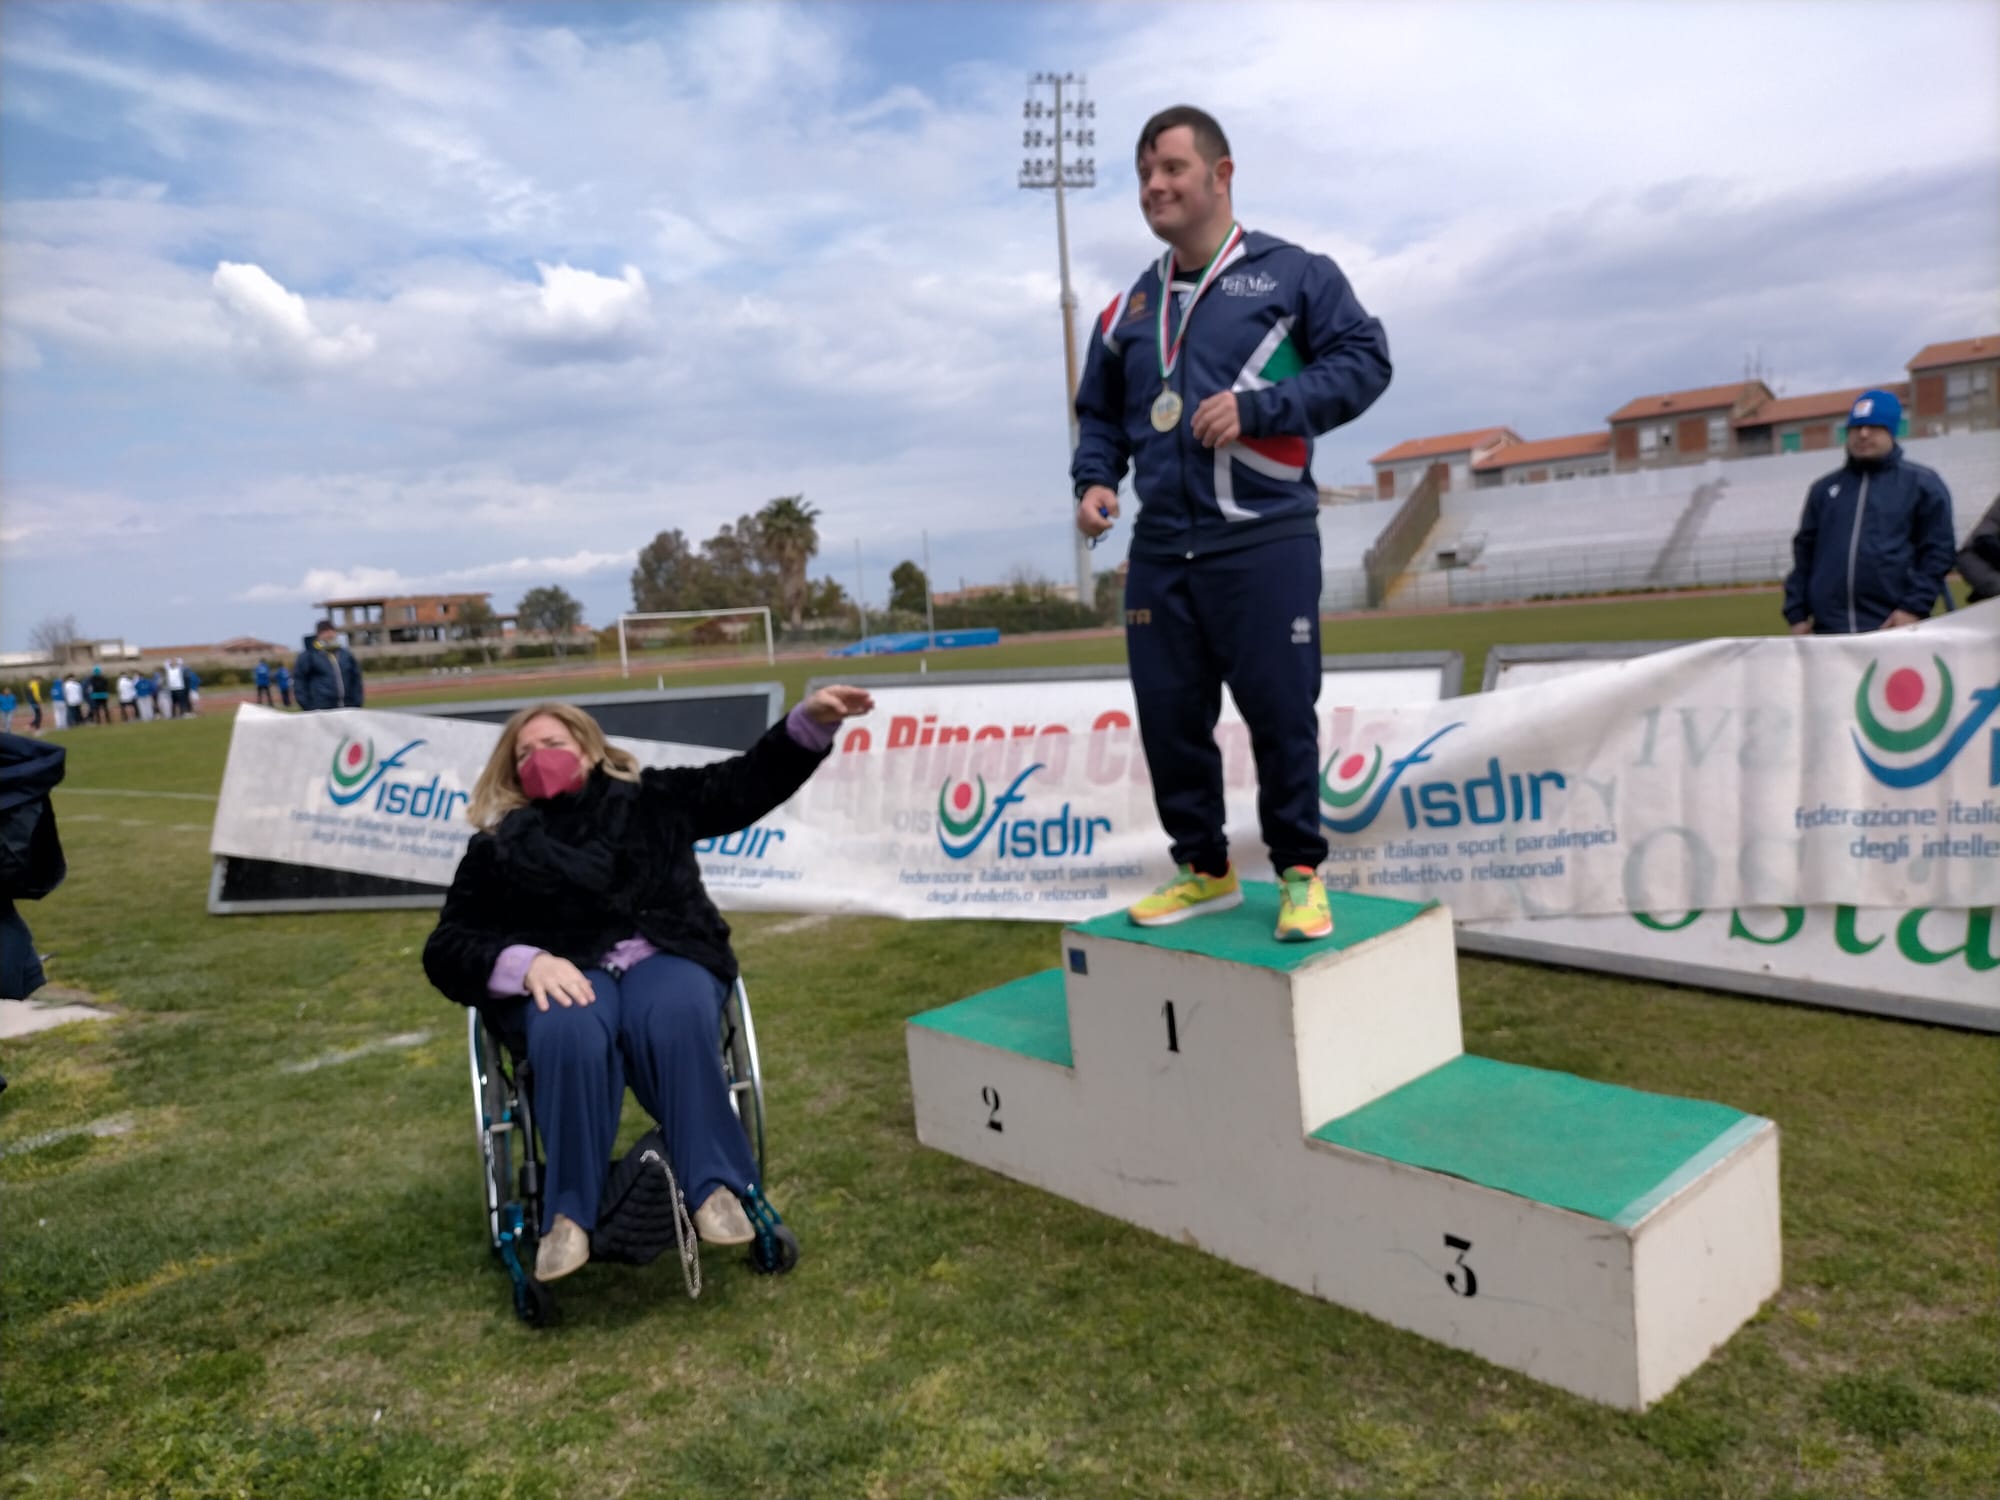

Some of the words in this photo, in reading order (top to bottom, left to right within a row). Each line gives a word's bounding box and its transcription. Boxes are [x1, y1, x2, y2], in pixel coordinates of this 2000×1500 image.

[1127, 609, 1152, 624] TA
[350, 737, 470, 822] fisdir
[1352, 722, 1566, 833] fisdir
[966, 762, 1112, 860] fisdir
[1384, 840, 1449, 860] italiana
[1457, 837, 1506, 858] sport
[1515, 824, 1617, 854] paralimpici
[1849, 833, 1910, 864] degli
[1368, 862, 1463, 886] intellettivo
[1471, 857, 1564, 881] relazionali
[1161, 999, 1180, 1054] 1
[981, 1085, 1003, 1133] 2
[1443, 1233, 1477, 1297] 3
